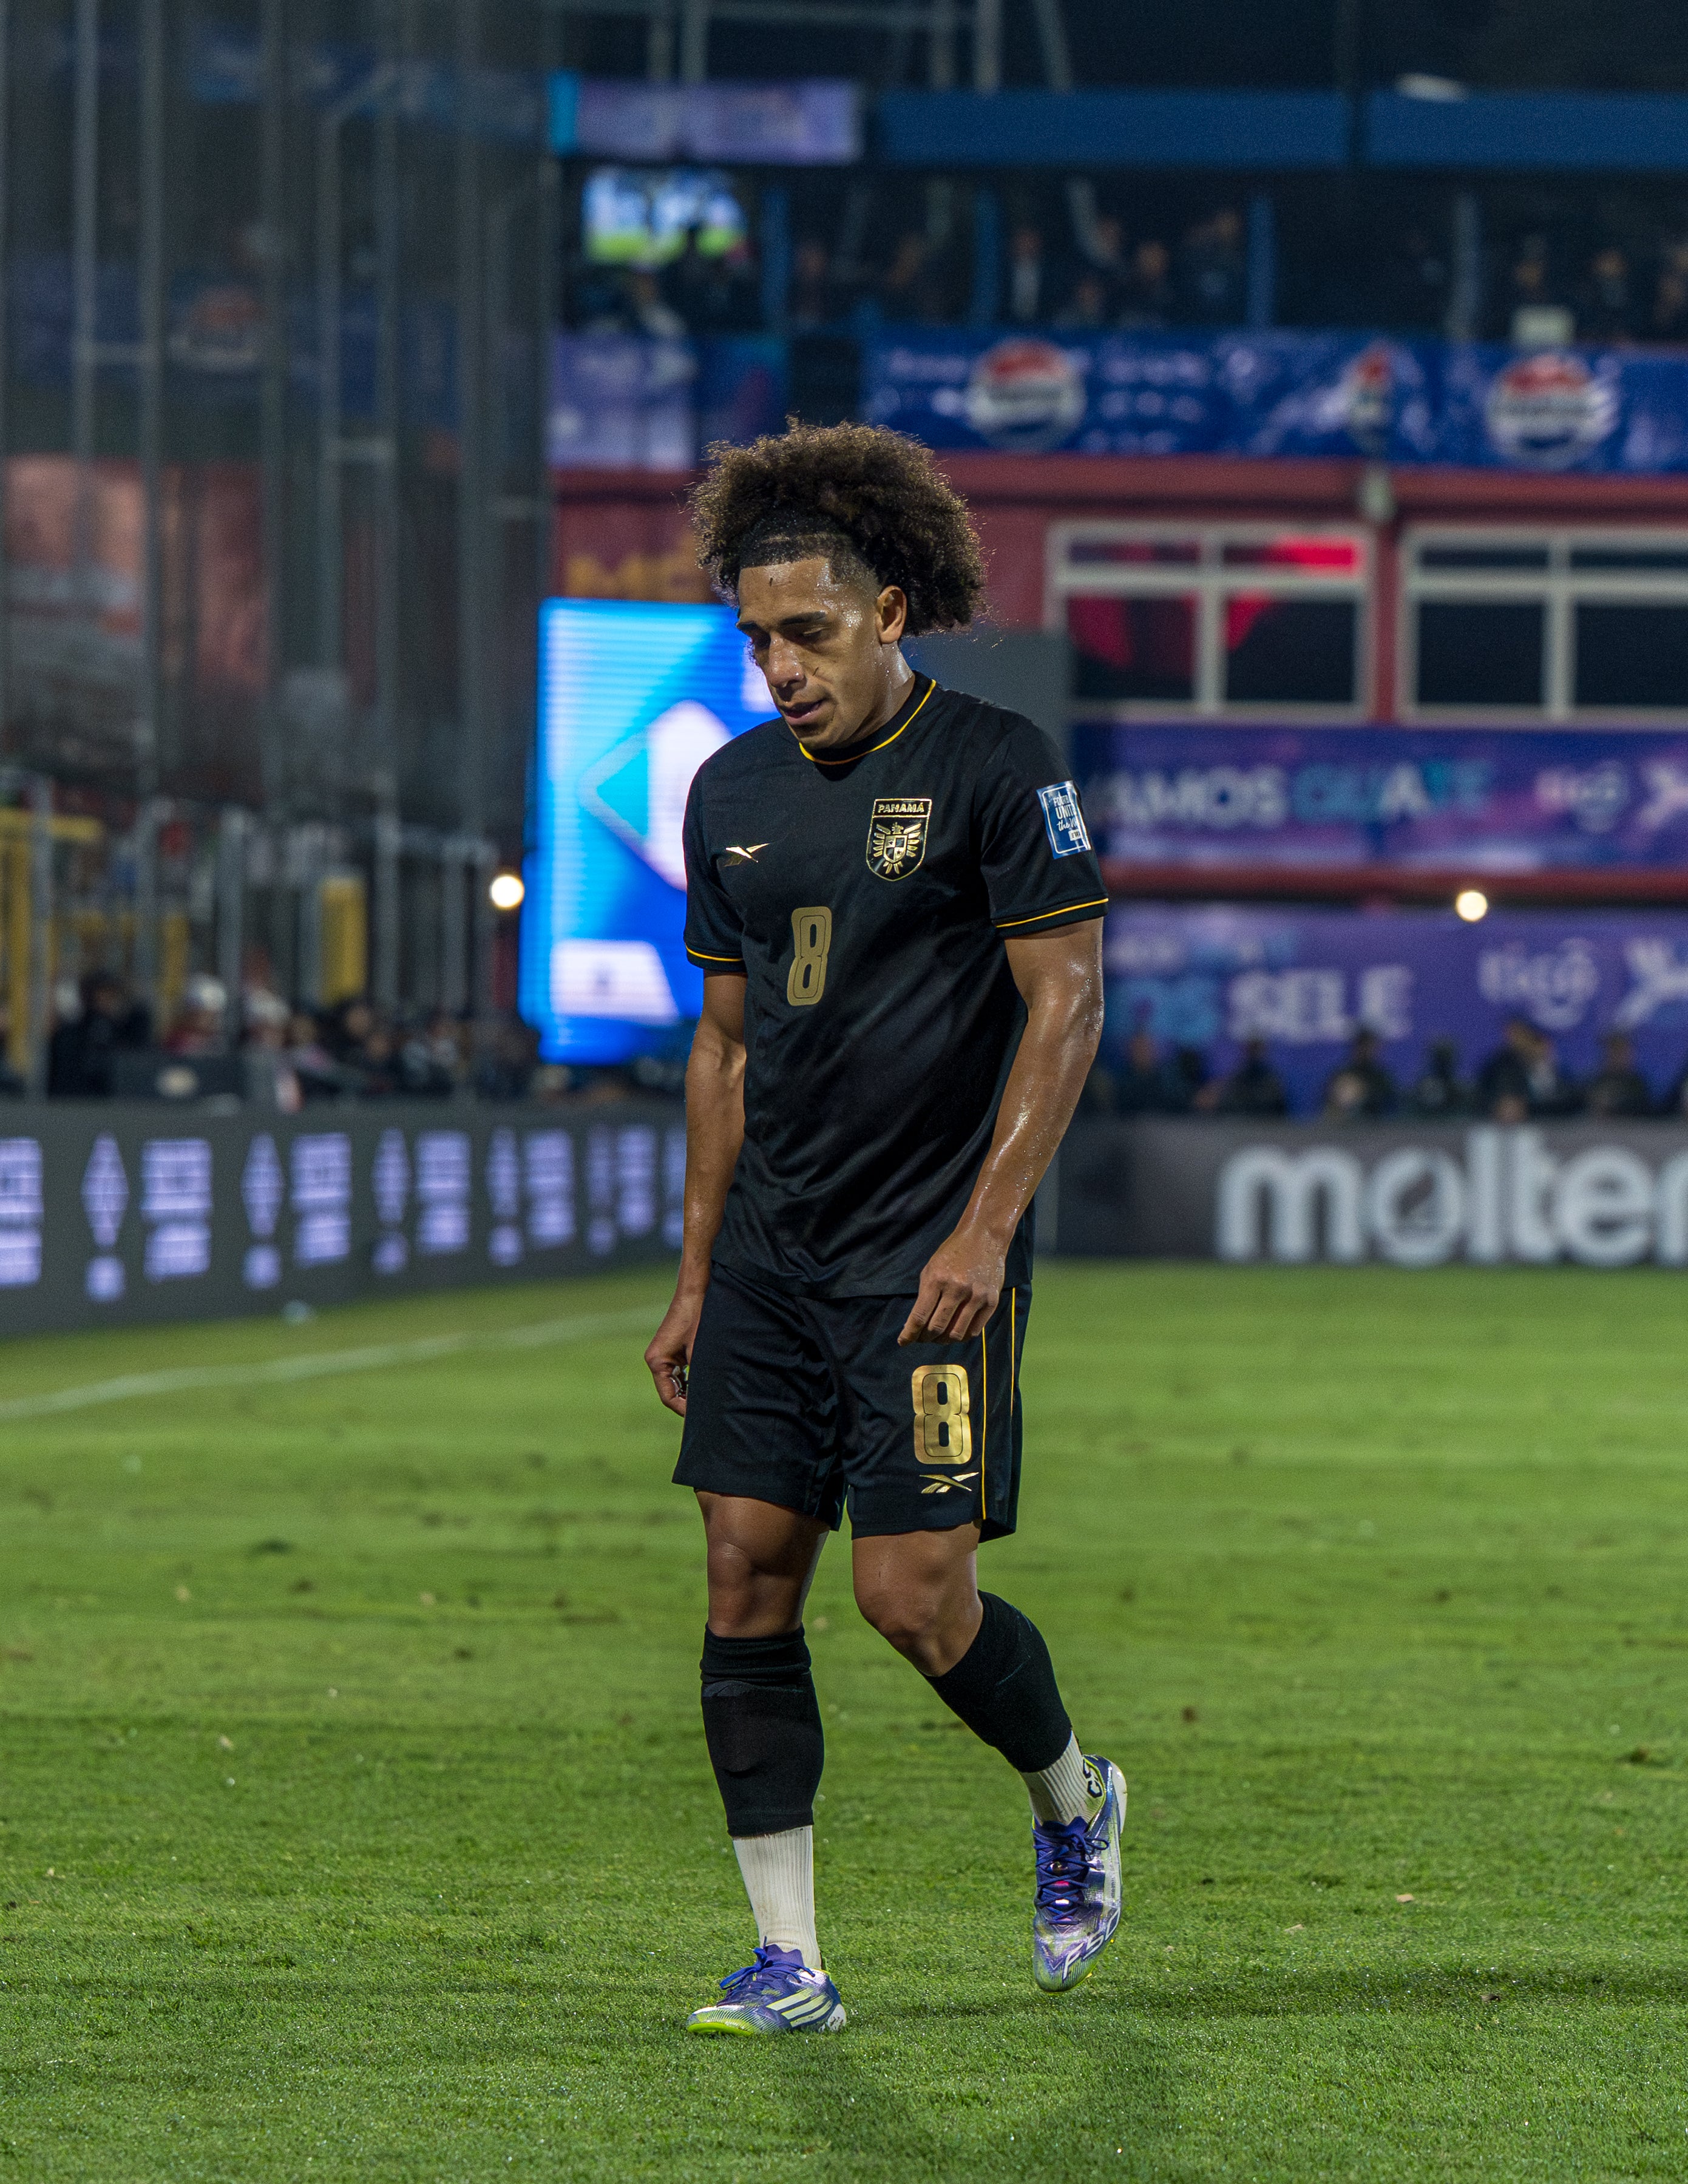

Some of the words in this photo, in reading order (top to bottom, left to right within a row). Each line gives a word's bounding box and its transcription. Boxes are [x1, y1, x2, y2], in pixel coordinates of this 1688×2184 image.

[878, 802, 924, 813] PANAMÁ
[1055, 804, 1075, 819] UNIT
[1094, 763, 1288, 830] AMOS
[1057, 820, 1070, 831] the
[787, 906, 832, 1006] 8
[912, 1365, 972, 1464] 8
